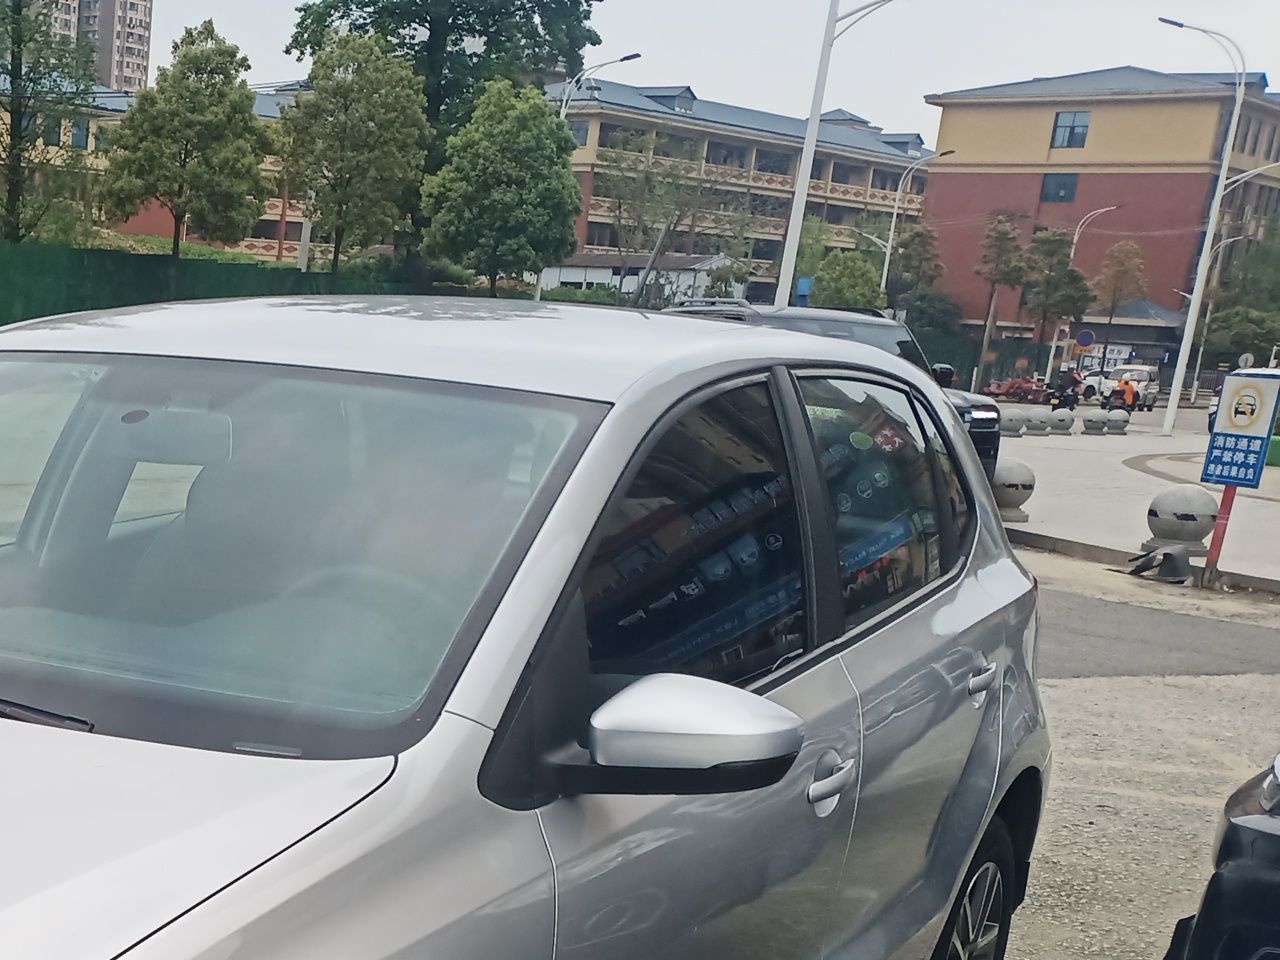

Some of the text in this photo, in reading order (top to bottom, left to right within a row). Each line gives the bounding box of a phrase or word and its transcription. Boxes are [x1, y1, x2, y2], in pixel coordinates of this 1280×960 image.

[1213, 435, 1262, 451] 消防通道
[1210, 449, 1258, 465] 严禁停车
[1206, 463, 1254, 480] 违者后果自负
